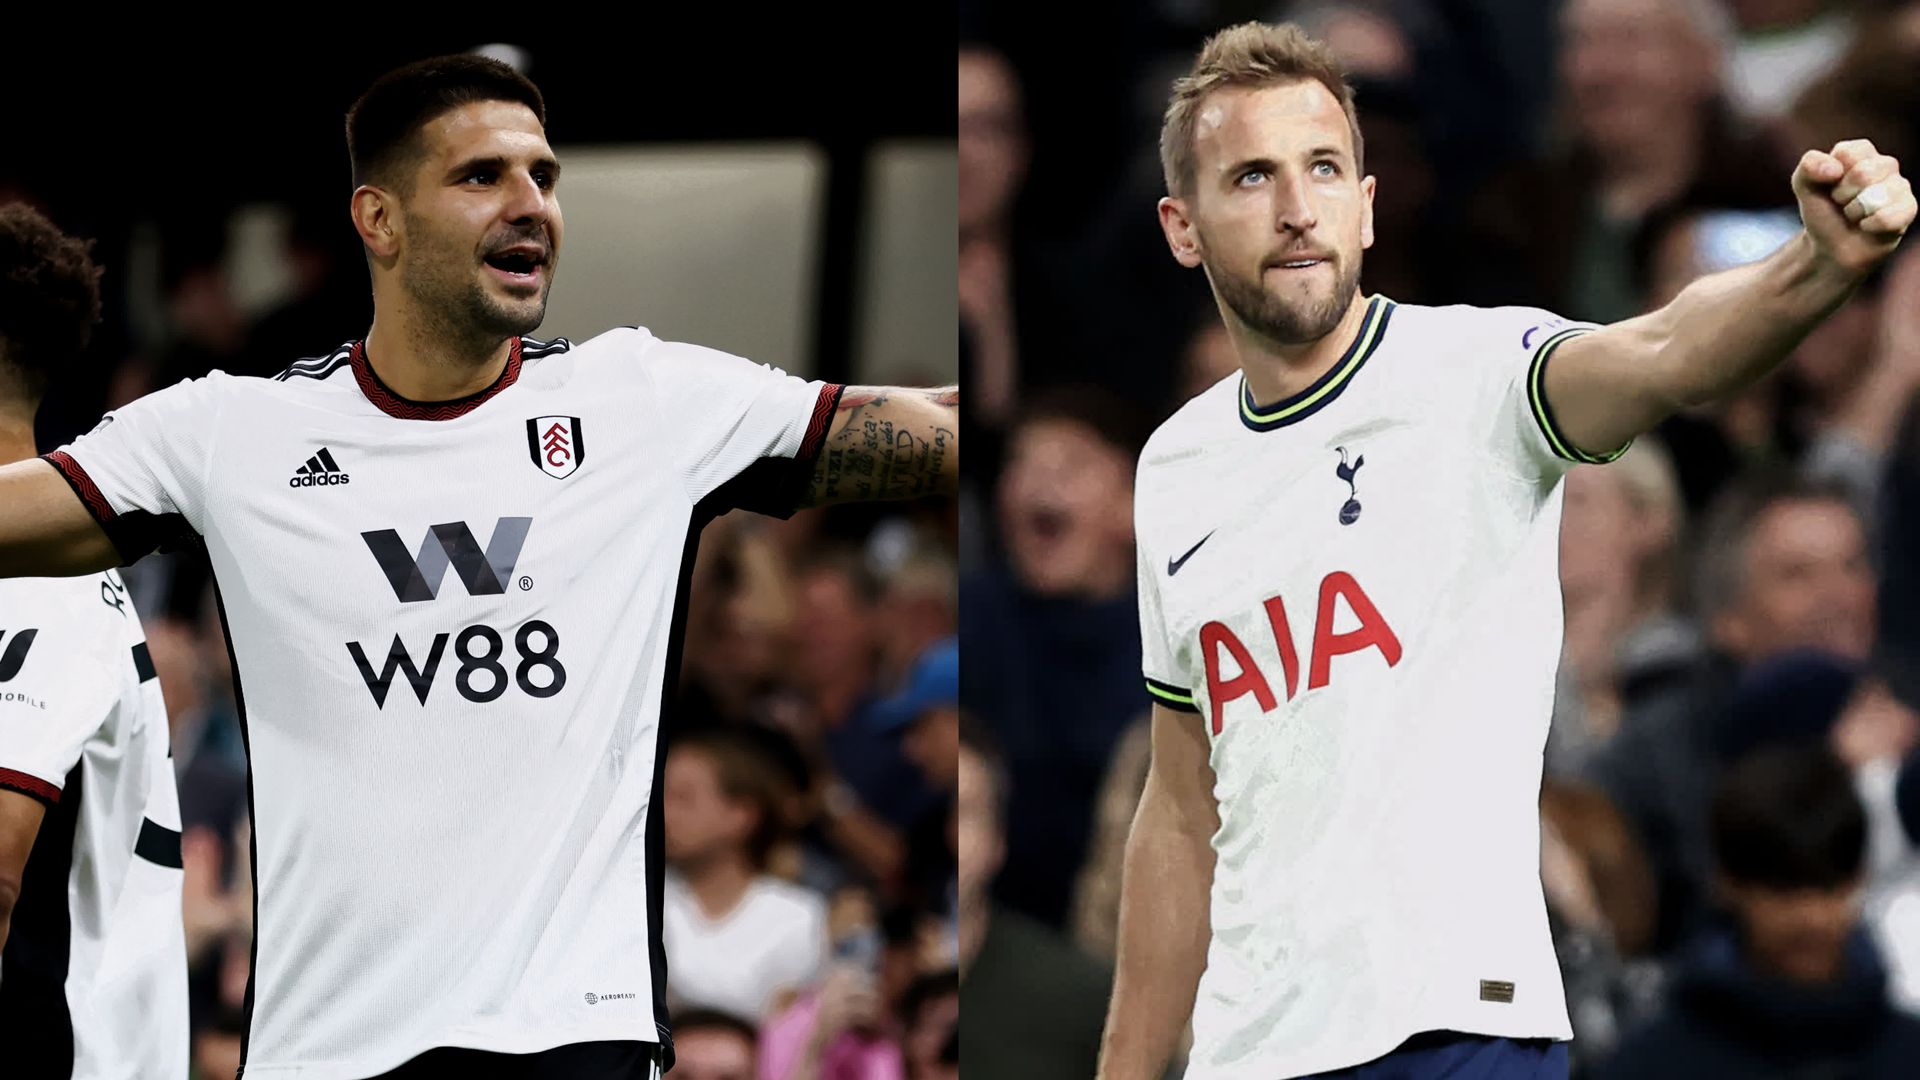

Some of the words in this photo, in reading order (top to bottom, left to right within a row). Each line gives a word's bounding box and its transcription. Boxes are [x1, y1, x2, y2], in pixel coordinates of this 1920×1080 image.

[289, 471, 350, 488] adidas
[345, 619, 567, 711] W88
[1199, 571, 1403, 737] AIA
[600, 993, 636, 1001] AEROREADY
